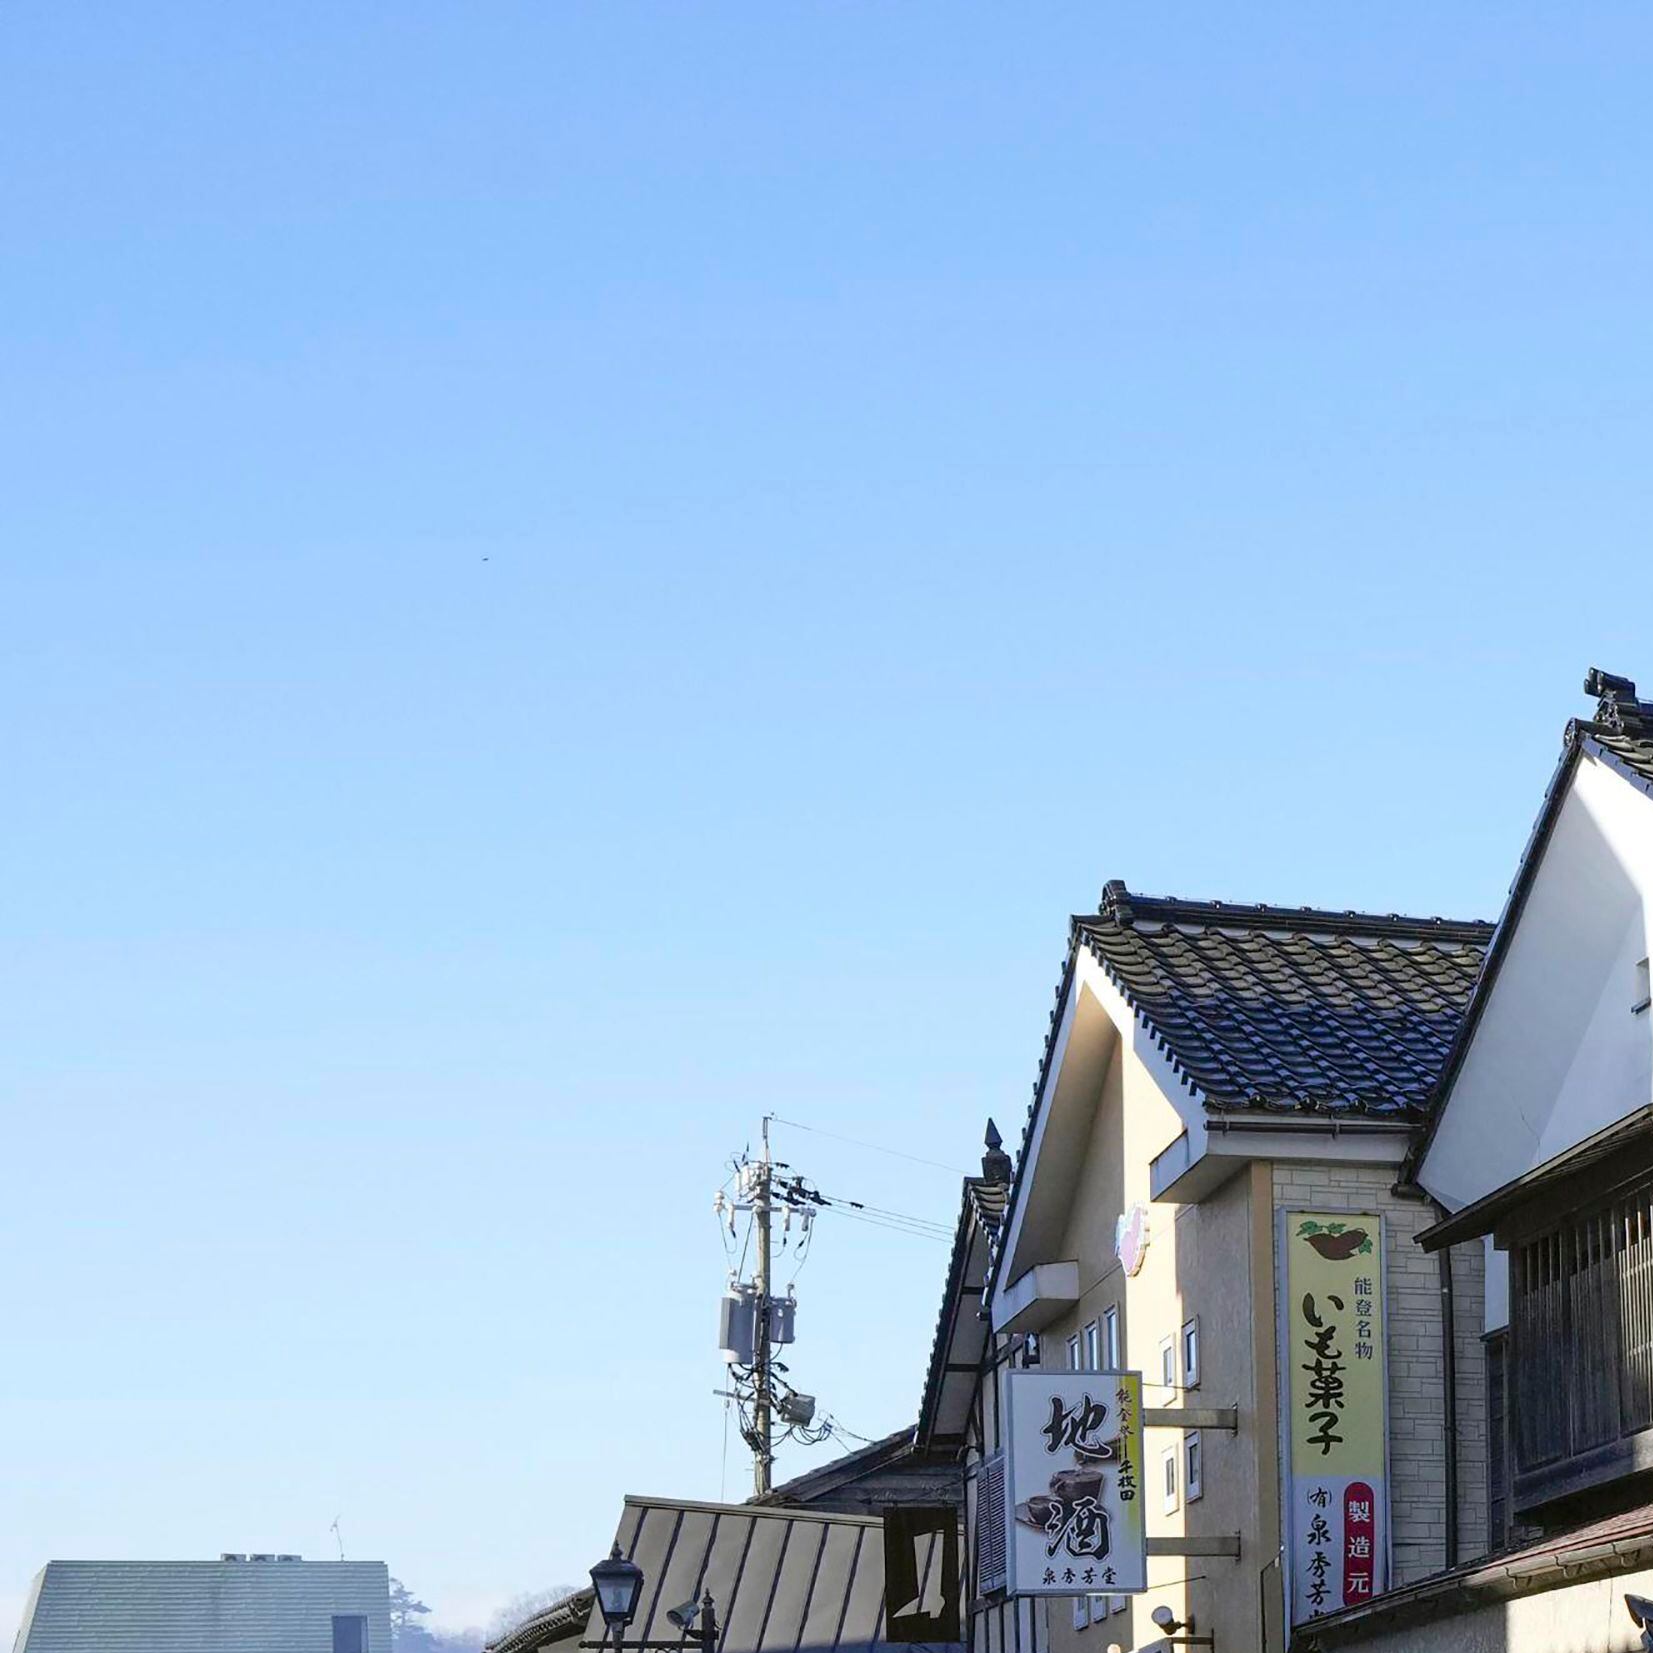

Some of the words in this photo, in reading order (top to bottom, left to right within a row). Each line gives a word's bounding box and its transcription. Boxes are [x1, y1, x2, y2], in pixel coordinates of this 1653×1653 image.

[1354, 1276, 1373, 1361] 能登名物
[1301, 1291, 1347, 1456] いも菓子
[1040, 1392, 1113, 1560] 地酒
[1117, 1458, 1137, 1502] 千枚田
[1042, 1565, 1118, 1586] 泉秀芳堂
[1347, 1500, 1371, 1594] 製造元
